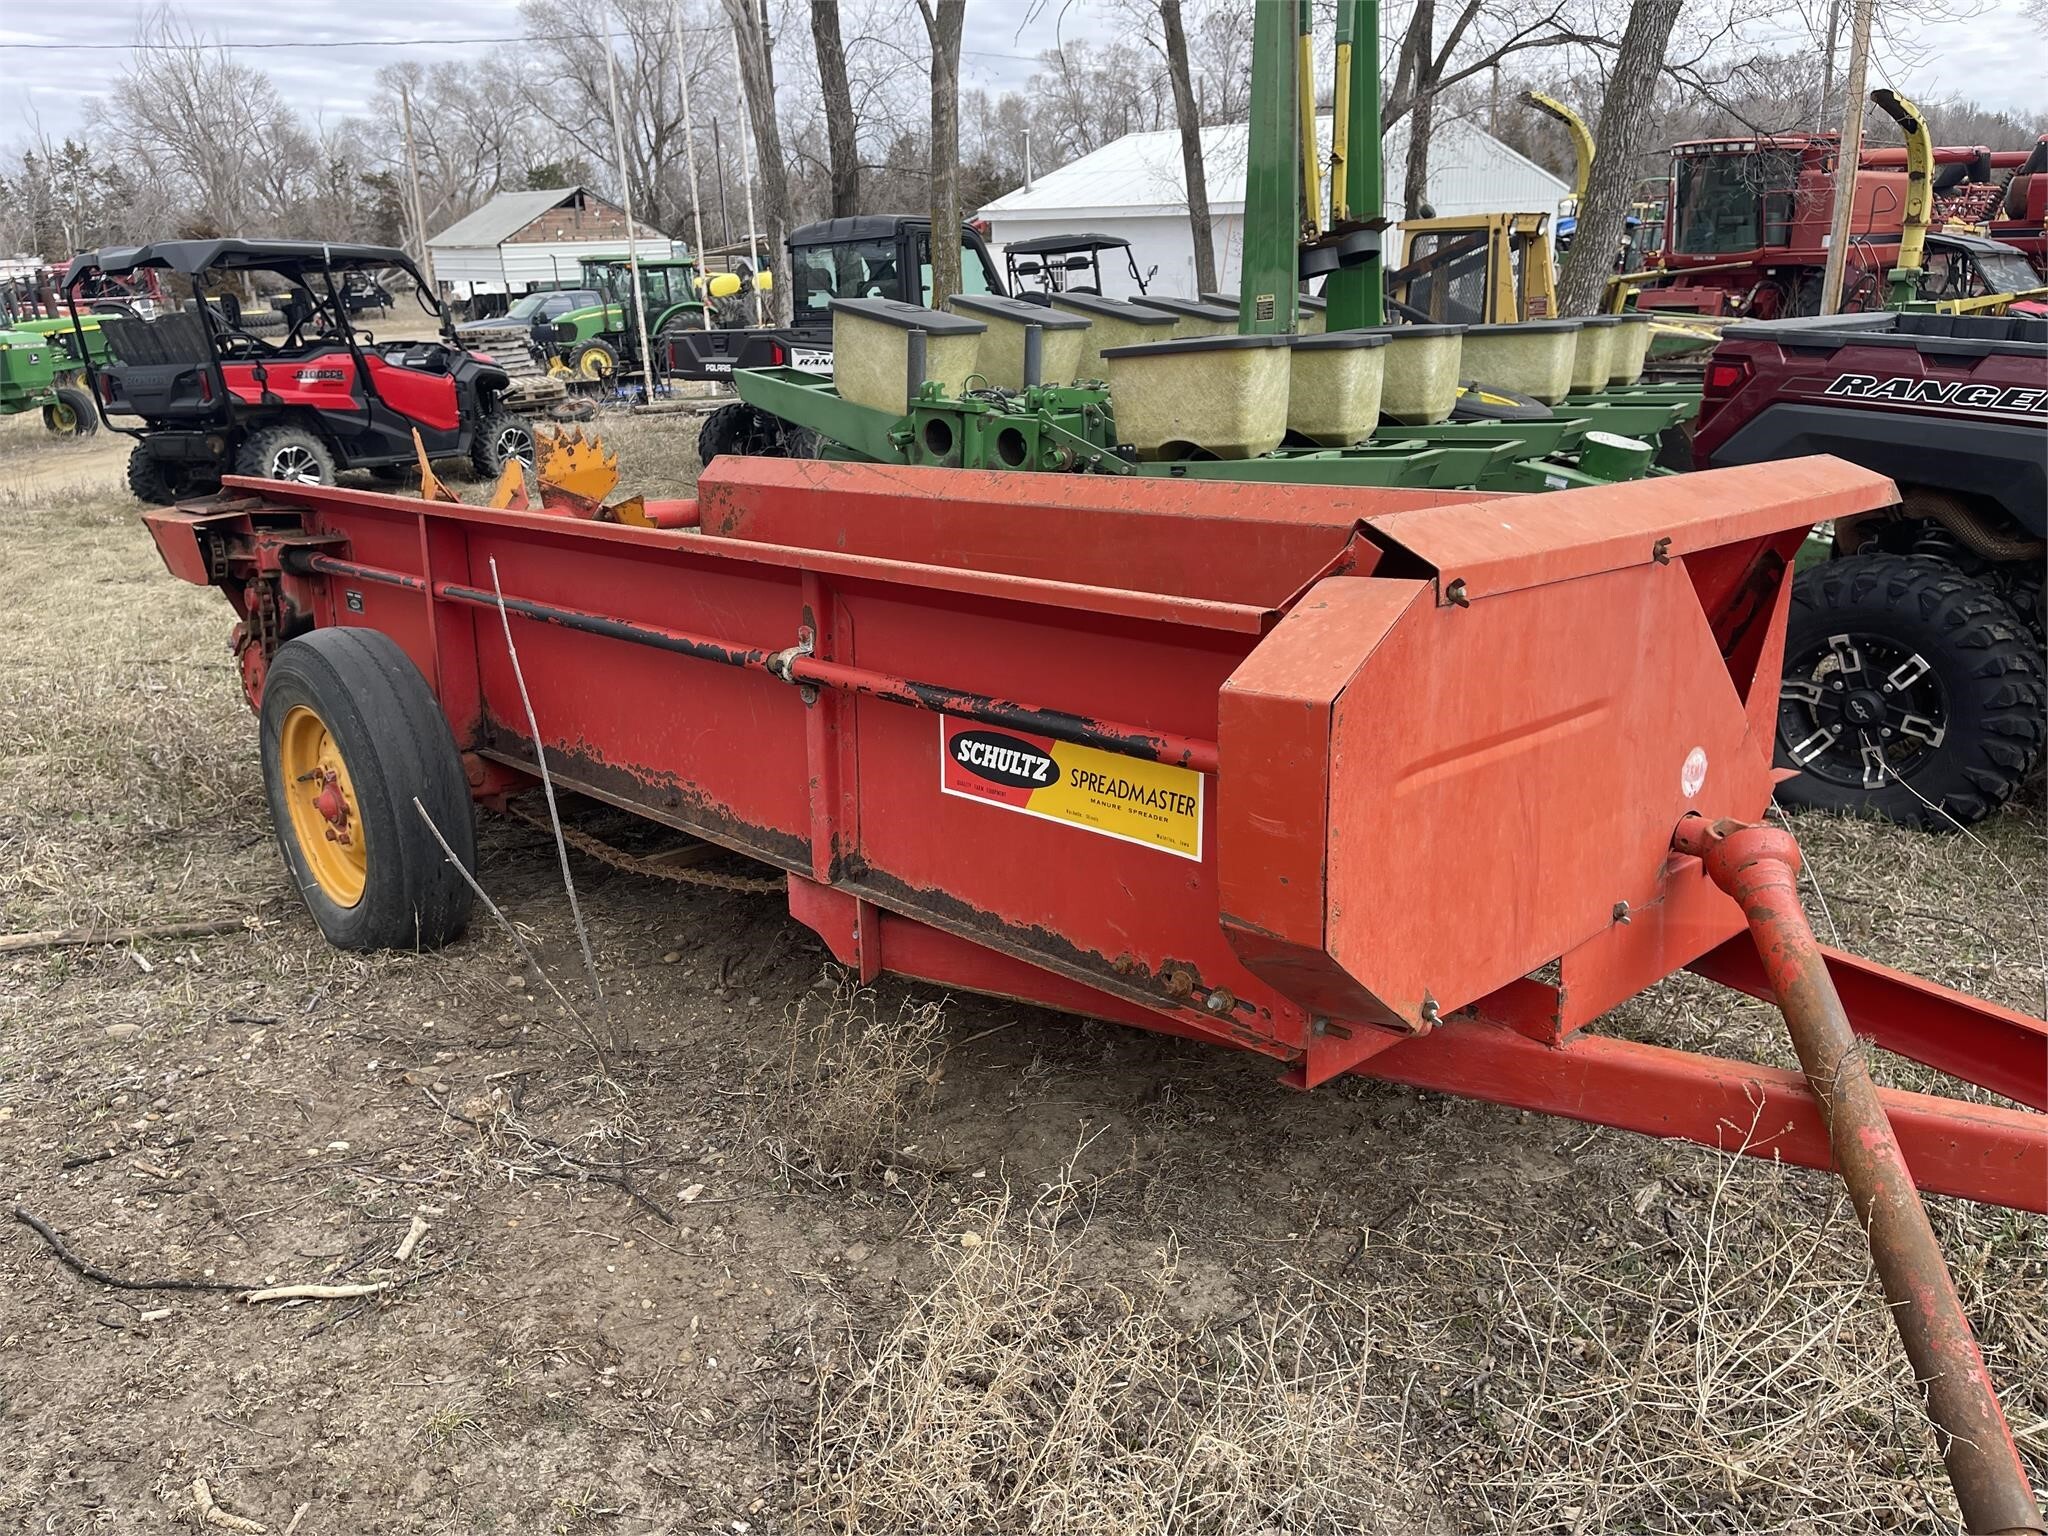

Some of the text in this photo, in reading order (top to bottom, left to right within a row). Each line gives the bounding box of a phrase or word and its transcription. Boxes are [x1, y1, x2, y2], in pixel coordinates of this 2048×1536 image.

[705, 363, 731, 373] POLARIS
[797, 358, 832, 367] RAN
[295, 369, 345, 380] PIONEER
[957, 739, 1051, 782] SCHULTZ
[1070, 768, 1197, 818] SPREADMASTER
[1090, 798, 1169, 823] MANURE SPREADER
